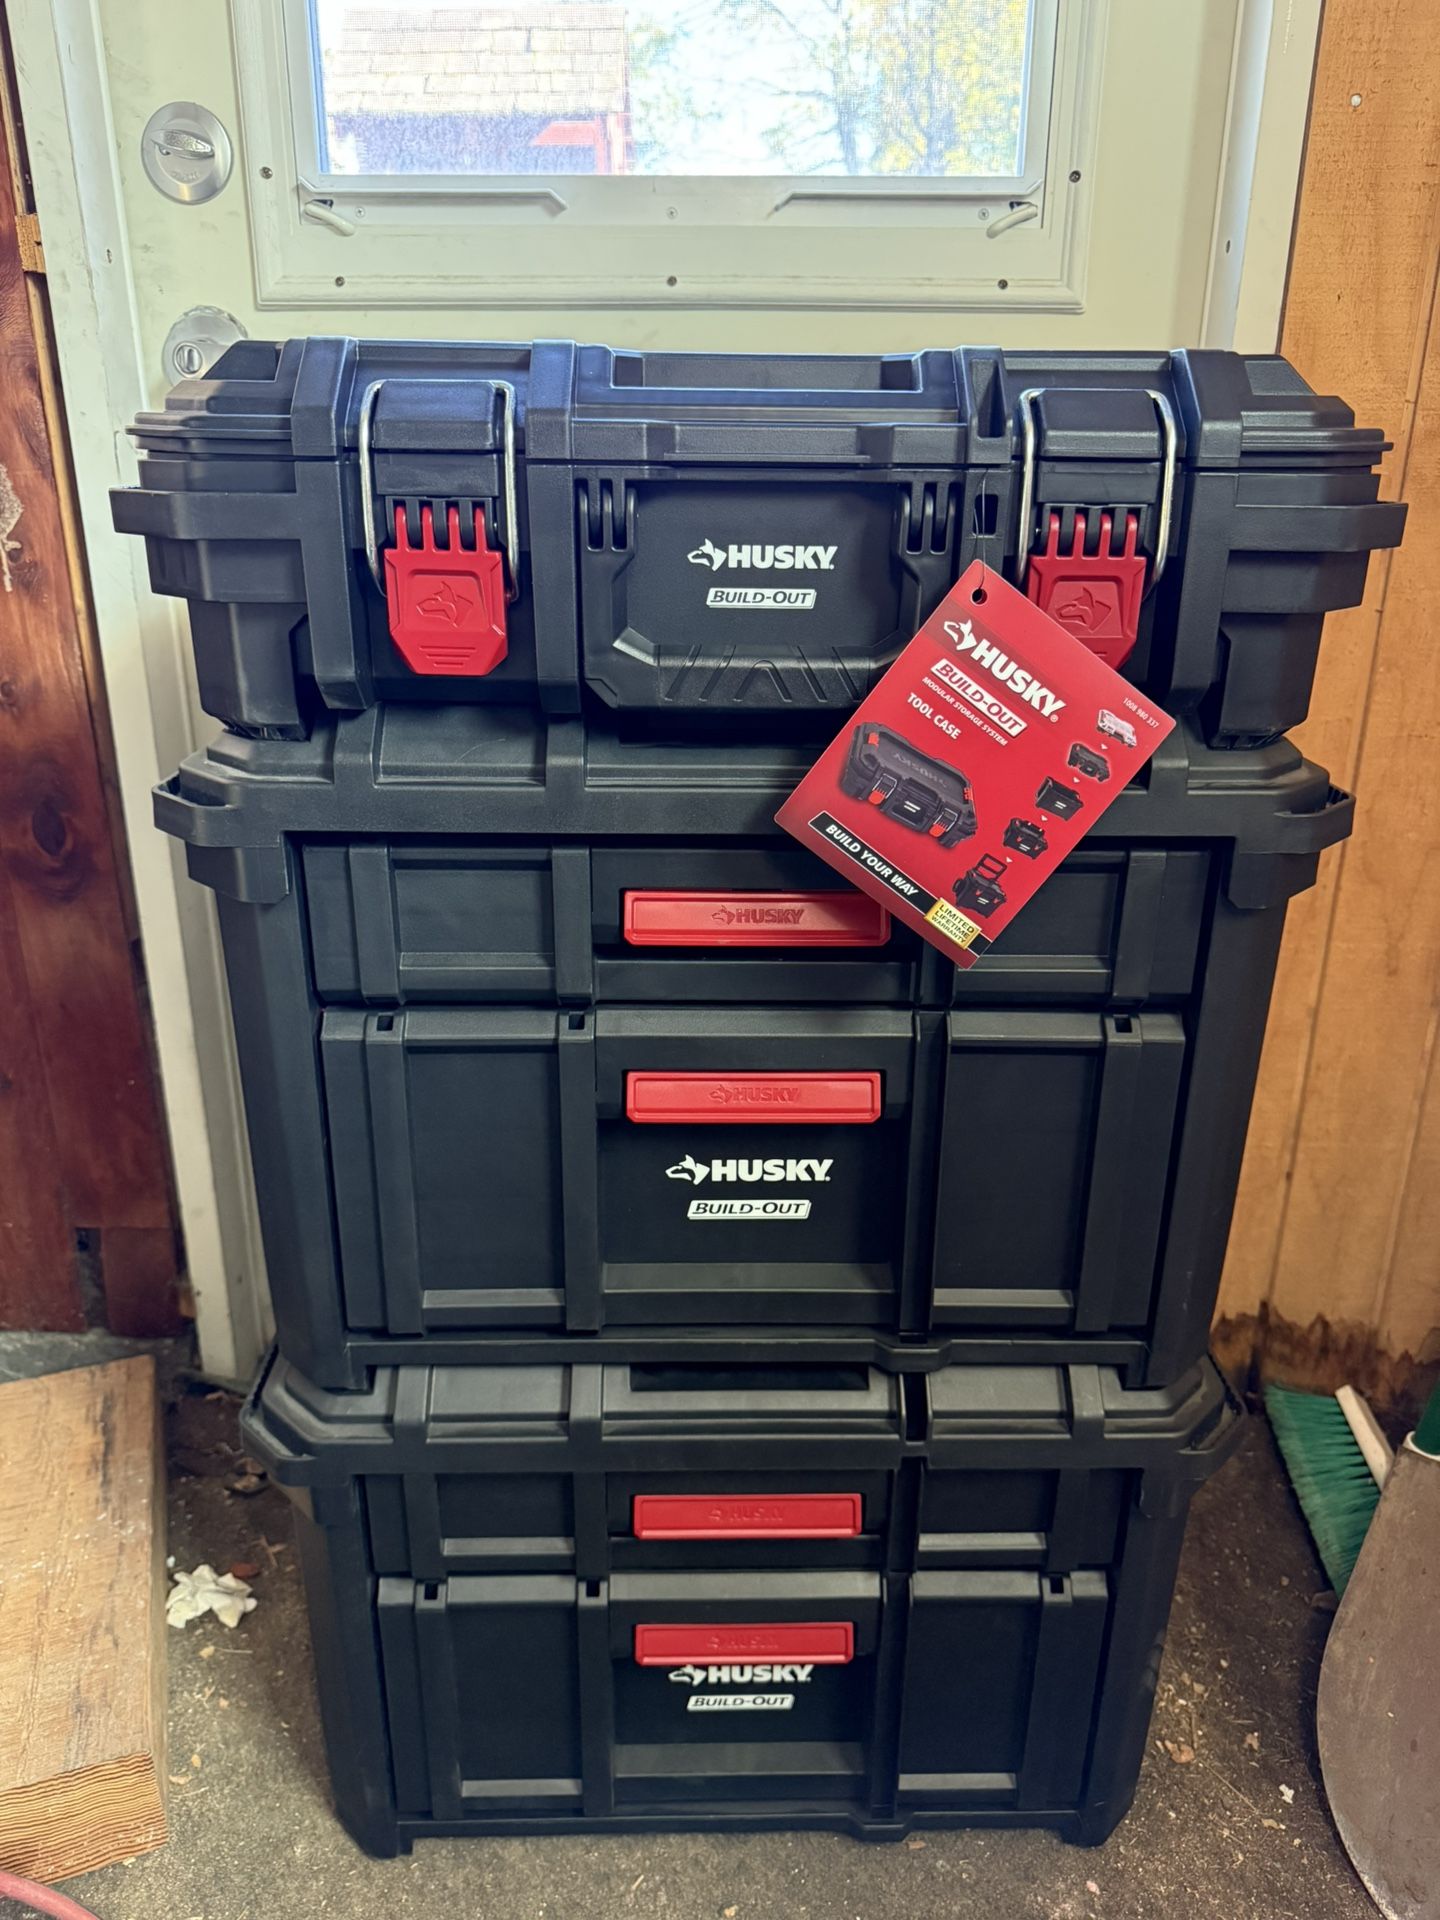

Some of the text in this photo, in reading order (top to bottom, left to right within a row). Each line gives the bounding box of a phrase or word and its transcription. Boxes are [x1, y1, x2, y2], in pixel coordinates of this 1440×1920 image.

[728, 544, 838, 570] HUSKY
[710, 590, 811, 604] BUILD-OUT
[970, 638, 1067, 718] HUSKY
[935, 663, 1023, 733] BUILD-OUT
[1123, 698, 1138, 712] 1008
[907, 692, 962, 740] TOOL CASE
[922, 677, 1008, 746] MODULAR STORAGE SYSTEM
[825, 824, 919, 896] BUILD YOUR WAY
[735, 907, 805, 925] HUSKY
[931, 915, 966, 943] WARRANTY
[935, 910, 970, 939] LIFETIME
[939, 904, 974, 933] LIMITED
[732, 1086, 801, 1104] HUSKY
[711, 1158, 834, 1182] HUSKY
[692, 1201, 806, 1215] BUILD-OUT
[706, 1664, 814, 1683] HUSKY
[693, 1696, 789, 1707] BUILD-OUT
